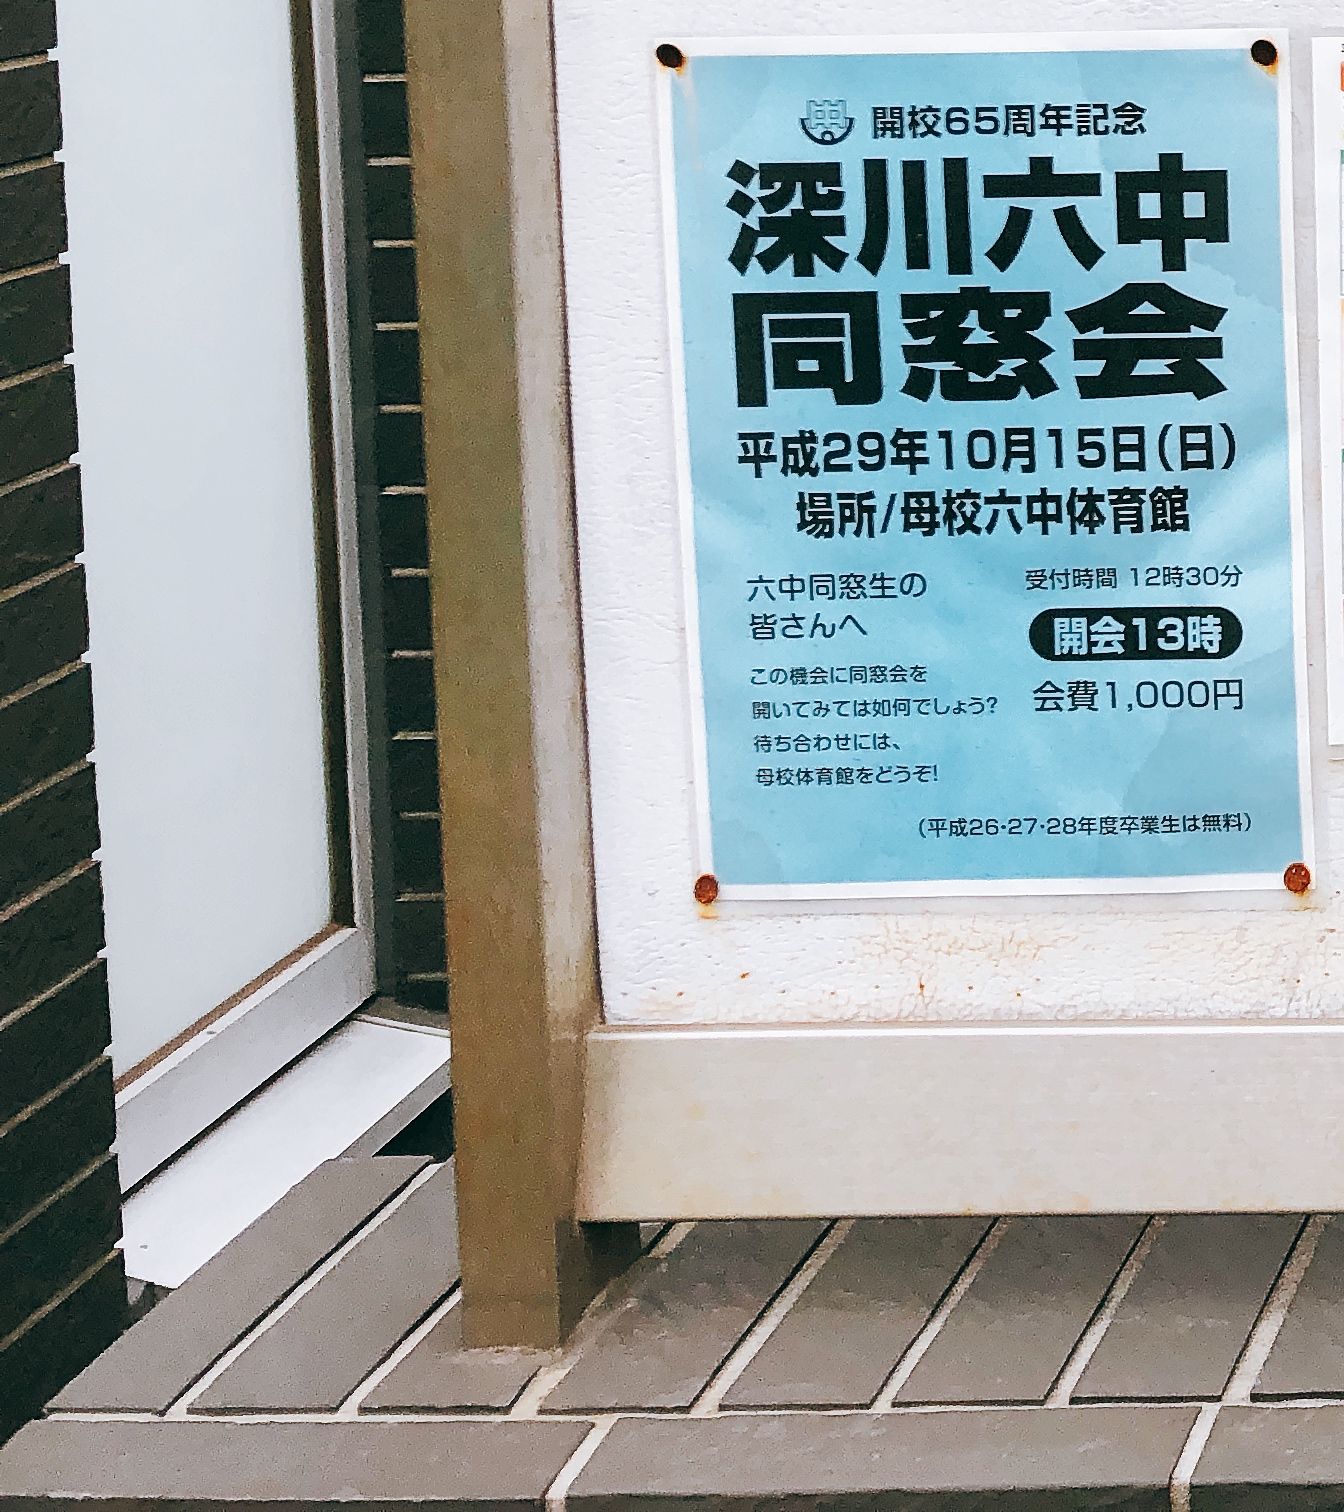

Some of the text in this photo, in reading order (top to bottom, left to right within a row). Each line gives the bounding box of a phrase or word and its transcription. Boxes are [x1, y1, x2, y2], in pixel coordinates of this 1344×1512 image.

[872, 102, 1147, 140] 開校65周年記念
[725, 152, 1232, 278] 深川六中
[732, 281, 1231, 408] 同窓会
[737, 422, 1237, 479] 平成29年10月15日(日)
[796, 486, 1191, 539] 場所/母校六中体育館
[746, 571, 928, 602] 六中同窓生の
[1025, 565, 1244, 591] 受付時間 12時30分
[750, 612, 868, 640] 皆さんへ
[1053, 615, 1223, 656] 開会13時
[750, 664, 928, 685] この機会に同窓会を
[752, 697, 999, 720] 開いてみては如何でしょう?
[1033, 678, 1245, 713] 会費1,000円
[754, 732, 901, 753] 待ち合わせには、
[755, 763, 939, 786] 母校体育館をどうぞ!
[918, 813, 1252, 840] (平成26・27・28年度卒業生は無料)
